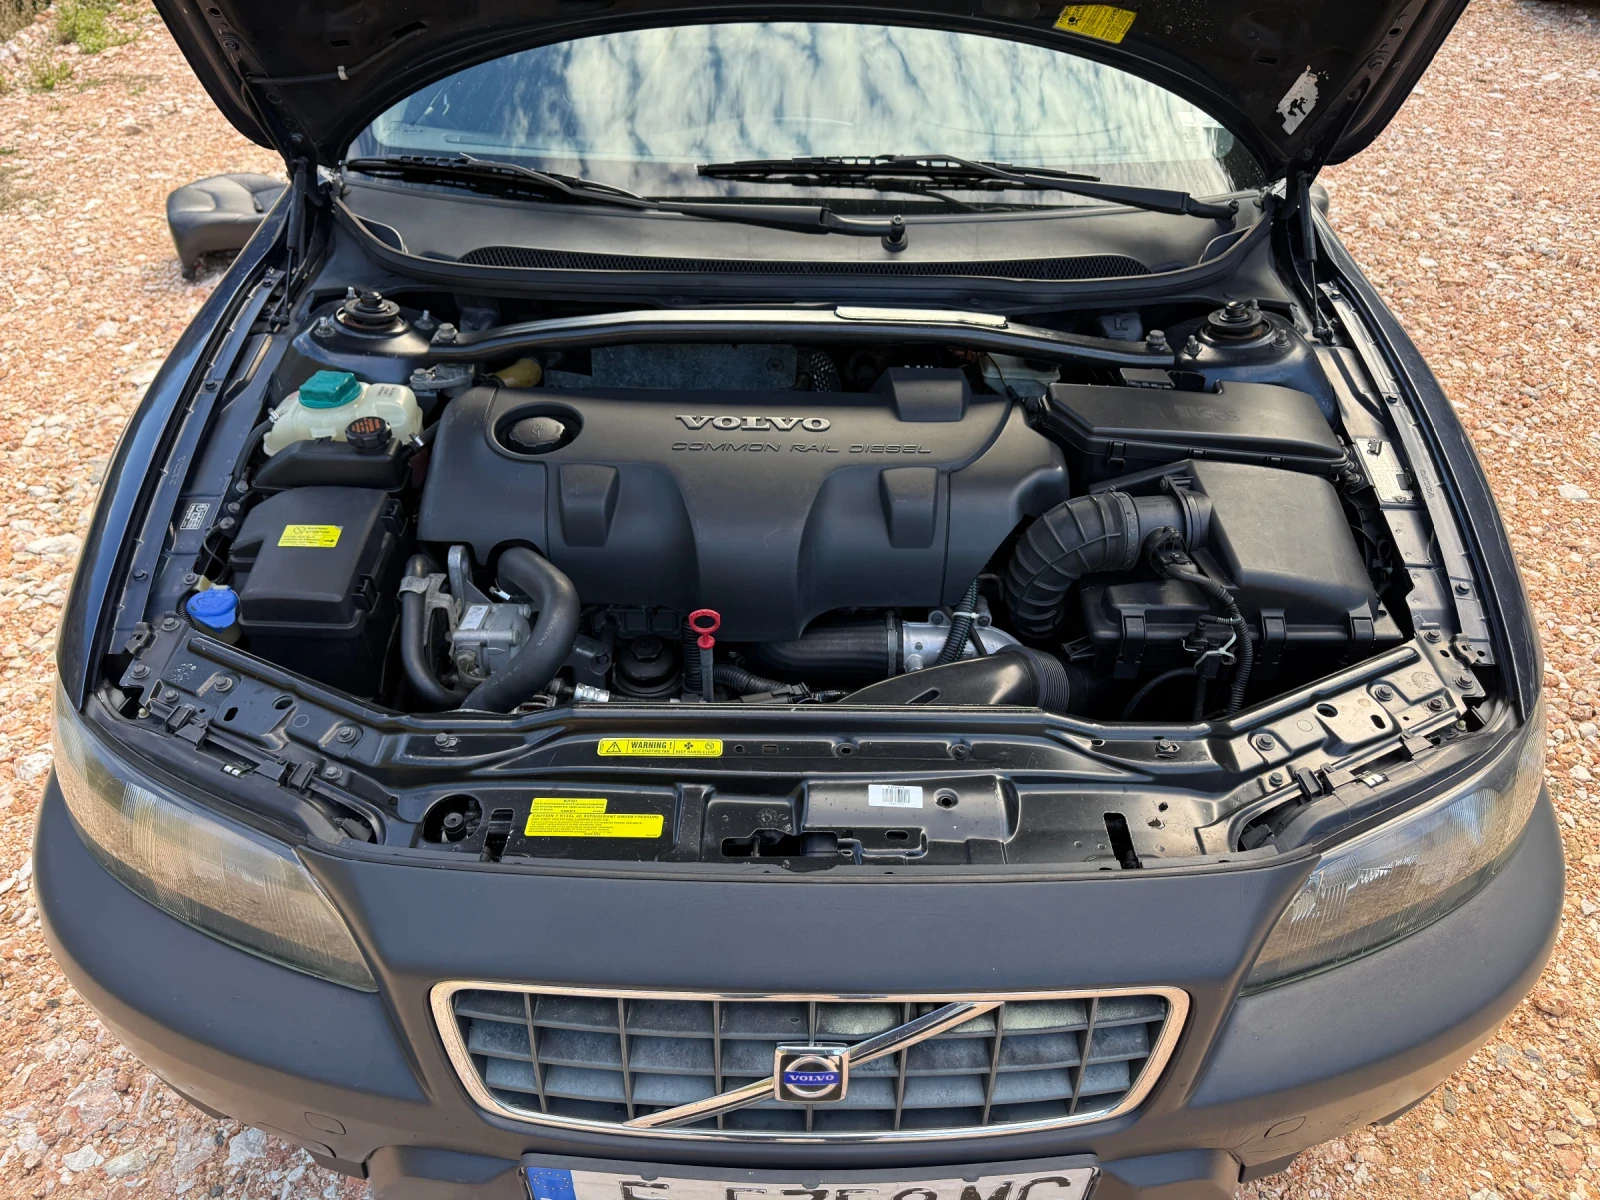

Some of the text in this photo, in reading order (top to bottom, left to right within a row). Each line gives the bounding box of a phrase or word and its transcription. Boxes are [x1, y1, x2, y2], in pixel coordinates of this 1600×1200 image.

[675, 414, 831, 432] VOLVO
[671, 441, 932, 453] COMMON RAIL DIESEL
[1420, 468, 1435, 499] VOLVO
[631, 741, 667, 749] WARNING
[788, 1074, 835, 1082] VOLVO
